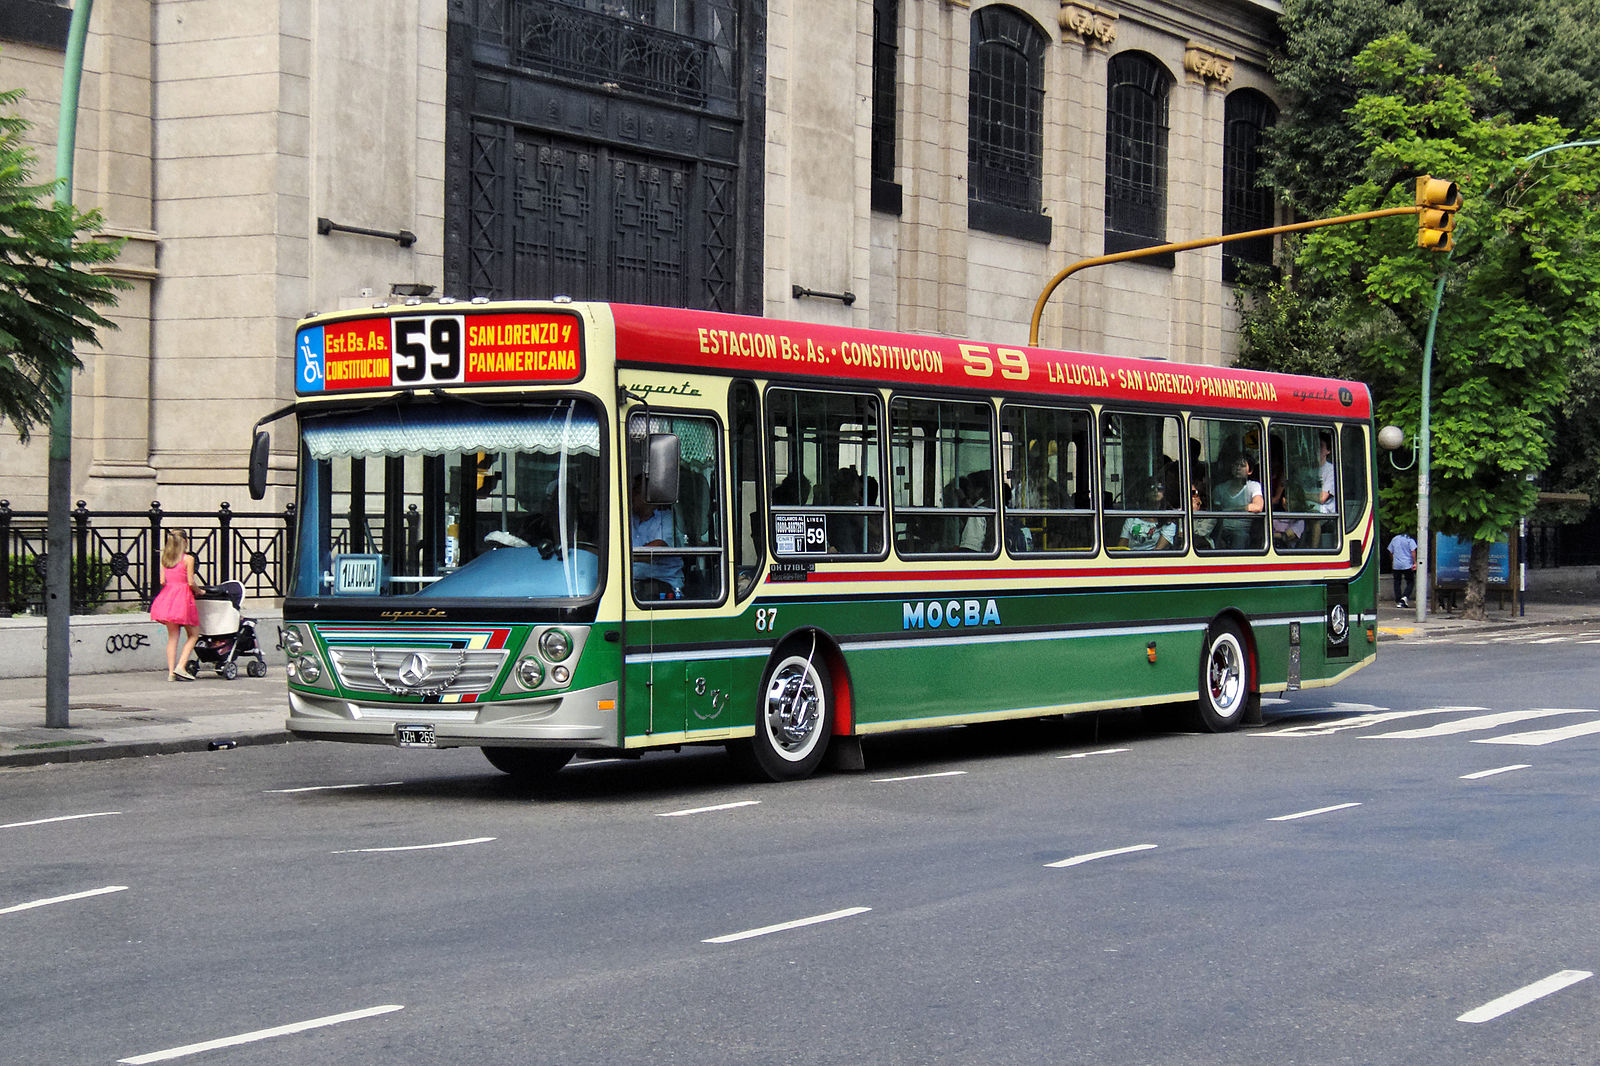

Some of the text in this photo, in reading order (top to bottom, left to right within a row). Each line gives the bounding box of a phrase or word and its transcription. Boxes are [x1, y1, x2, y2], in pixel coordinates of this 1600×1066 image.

[469, 325, 495, 346] SAN
[497, 323, 558, 345] LORENZO
[395, 318, 461, 382] 59
[469, 350, 576, 372] PANAMERICANA
[326, 358, 389, 380] CONSTITUCION
[698, 328, 777, 359] ESTACION
[841, 341, 944, 374] CONSTITUCION
[958, 343, 1030, 381] 59
[1047, 361, 1065, 384] LA
[1064, 363, 1109, 388] LUCILA
[1118, 368, 1143, 391] SAN
[1143, 371, 1194, 395] LORENZO
[1200, 376, 1278, 402] PANAMERICANA
[629, 381, 703, 400] ugarte
[807, 528, 825, 544] 59
[381, 607, 448, 621] ugarte
[756, 608, 777, 632] 87
[902, 599, 1001, 630] MOCBA
[401, 730, 436, 743] JZH 269
